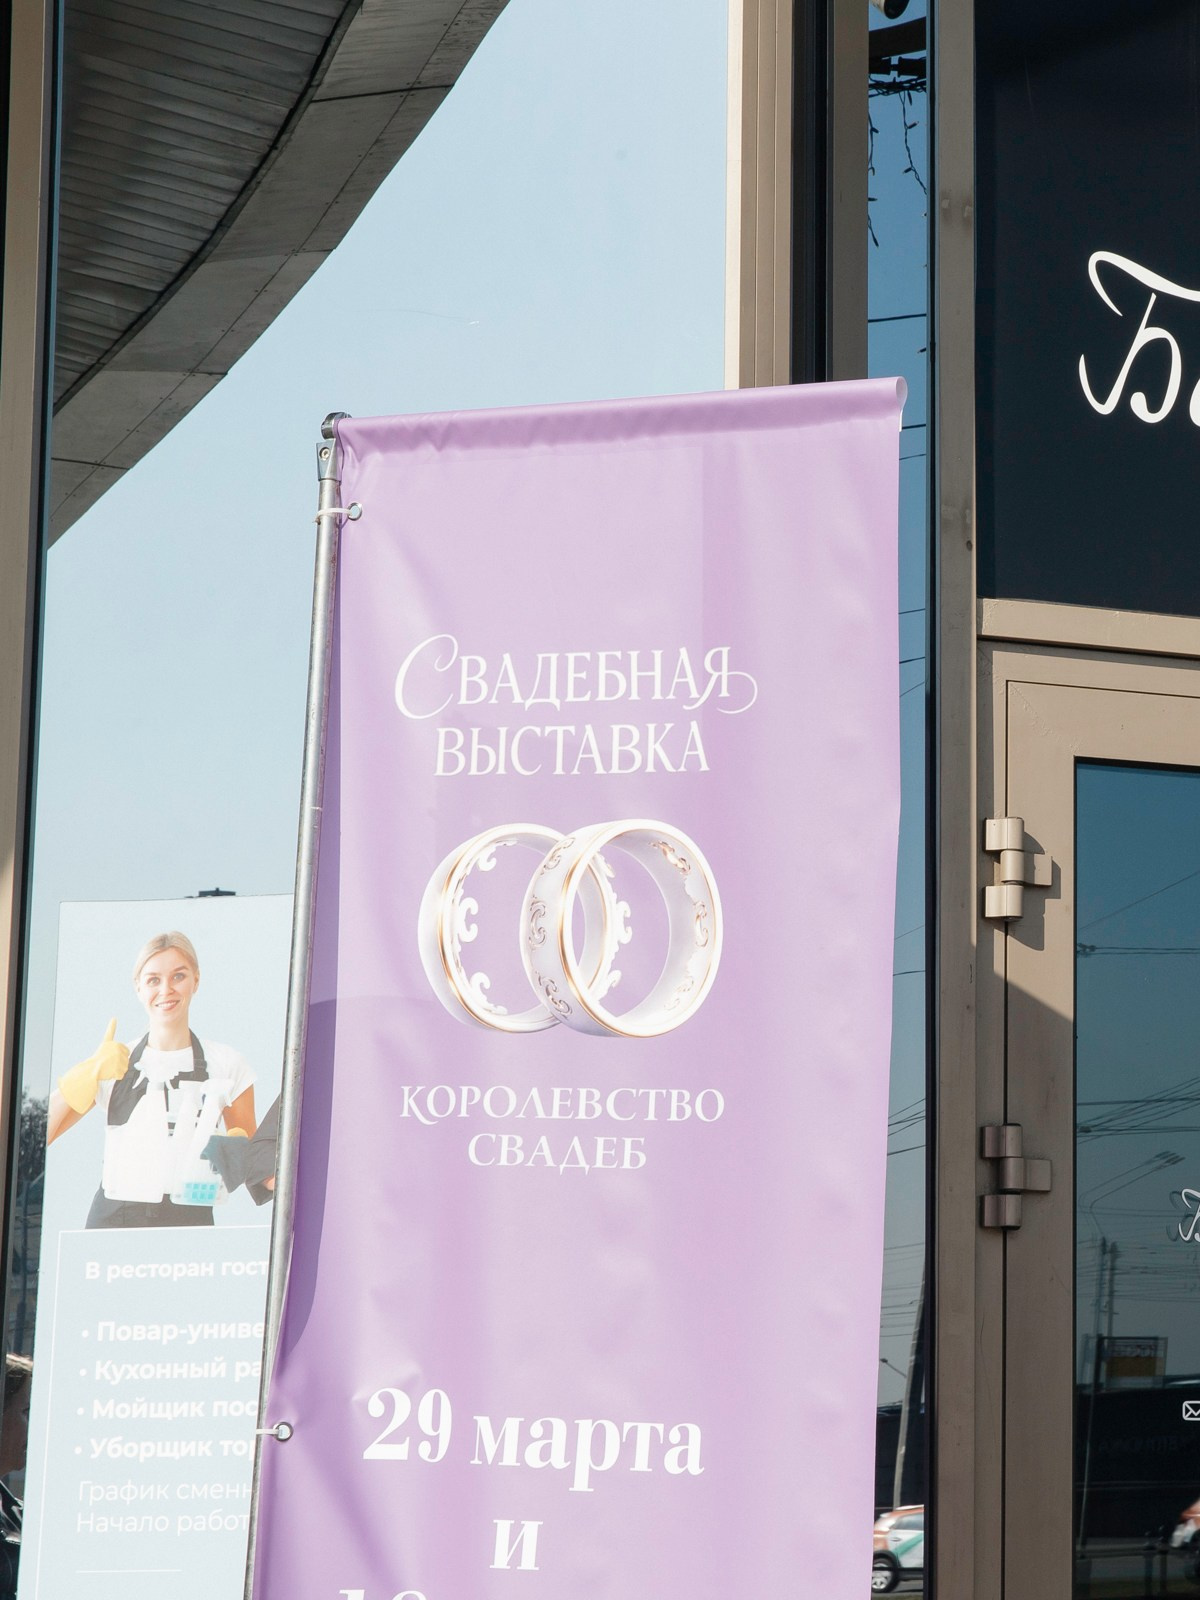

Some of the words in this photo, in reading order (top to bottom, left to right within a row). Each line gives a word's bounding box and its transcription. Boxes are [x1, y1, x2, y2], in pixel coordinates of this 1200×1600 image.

[394, 633, 758, 720] СВАДЕБНАЯ
[433, 719, 711, 777] ВЫСТАВКА
[399, 1084, 726, 1126] КОРОЛЕВСТВО
[467, 1132, 648, 1176] СВАДЕБ
[85, 1261, 100, 1280] В
[106, 1262, 215, 1284] ресторан
[221, 1260, 269, 1276] гост
[97, 1320, 265, 1346] Повар-униве
[95, 1356, 227, 1385] Кухонный
[234, 1361, 261, 1383] ра
[92, 1397, 206, 1421] Мойщик
[212, 1400, 258, 1417] пос
[89, 1436, 213, 1463] Уборщик
[362, 1387, 453, 1463] 29
[470, 1414, 705, 1492] марта
[79, 1479, 170, 1506] График
[76, 1512, 170, 1533] Начало
